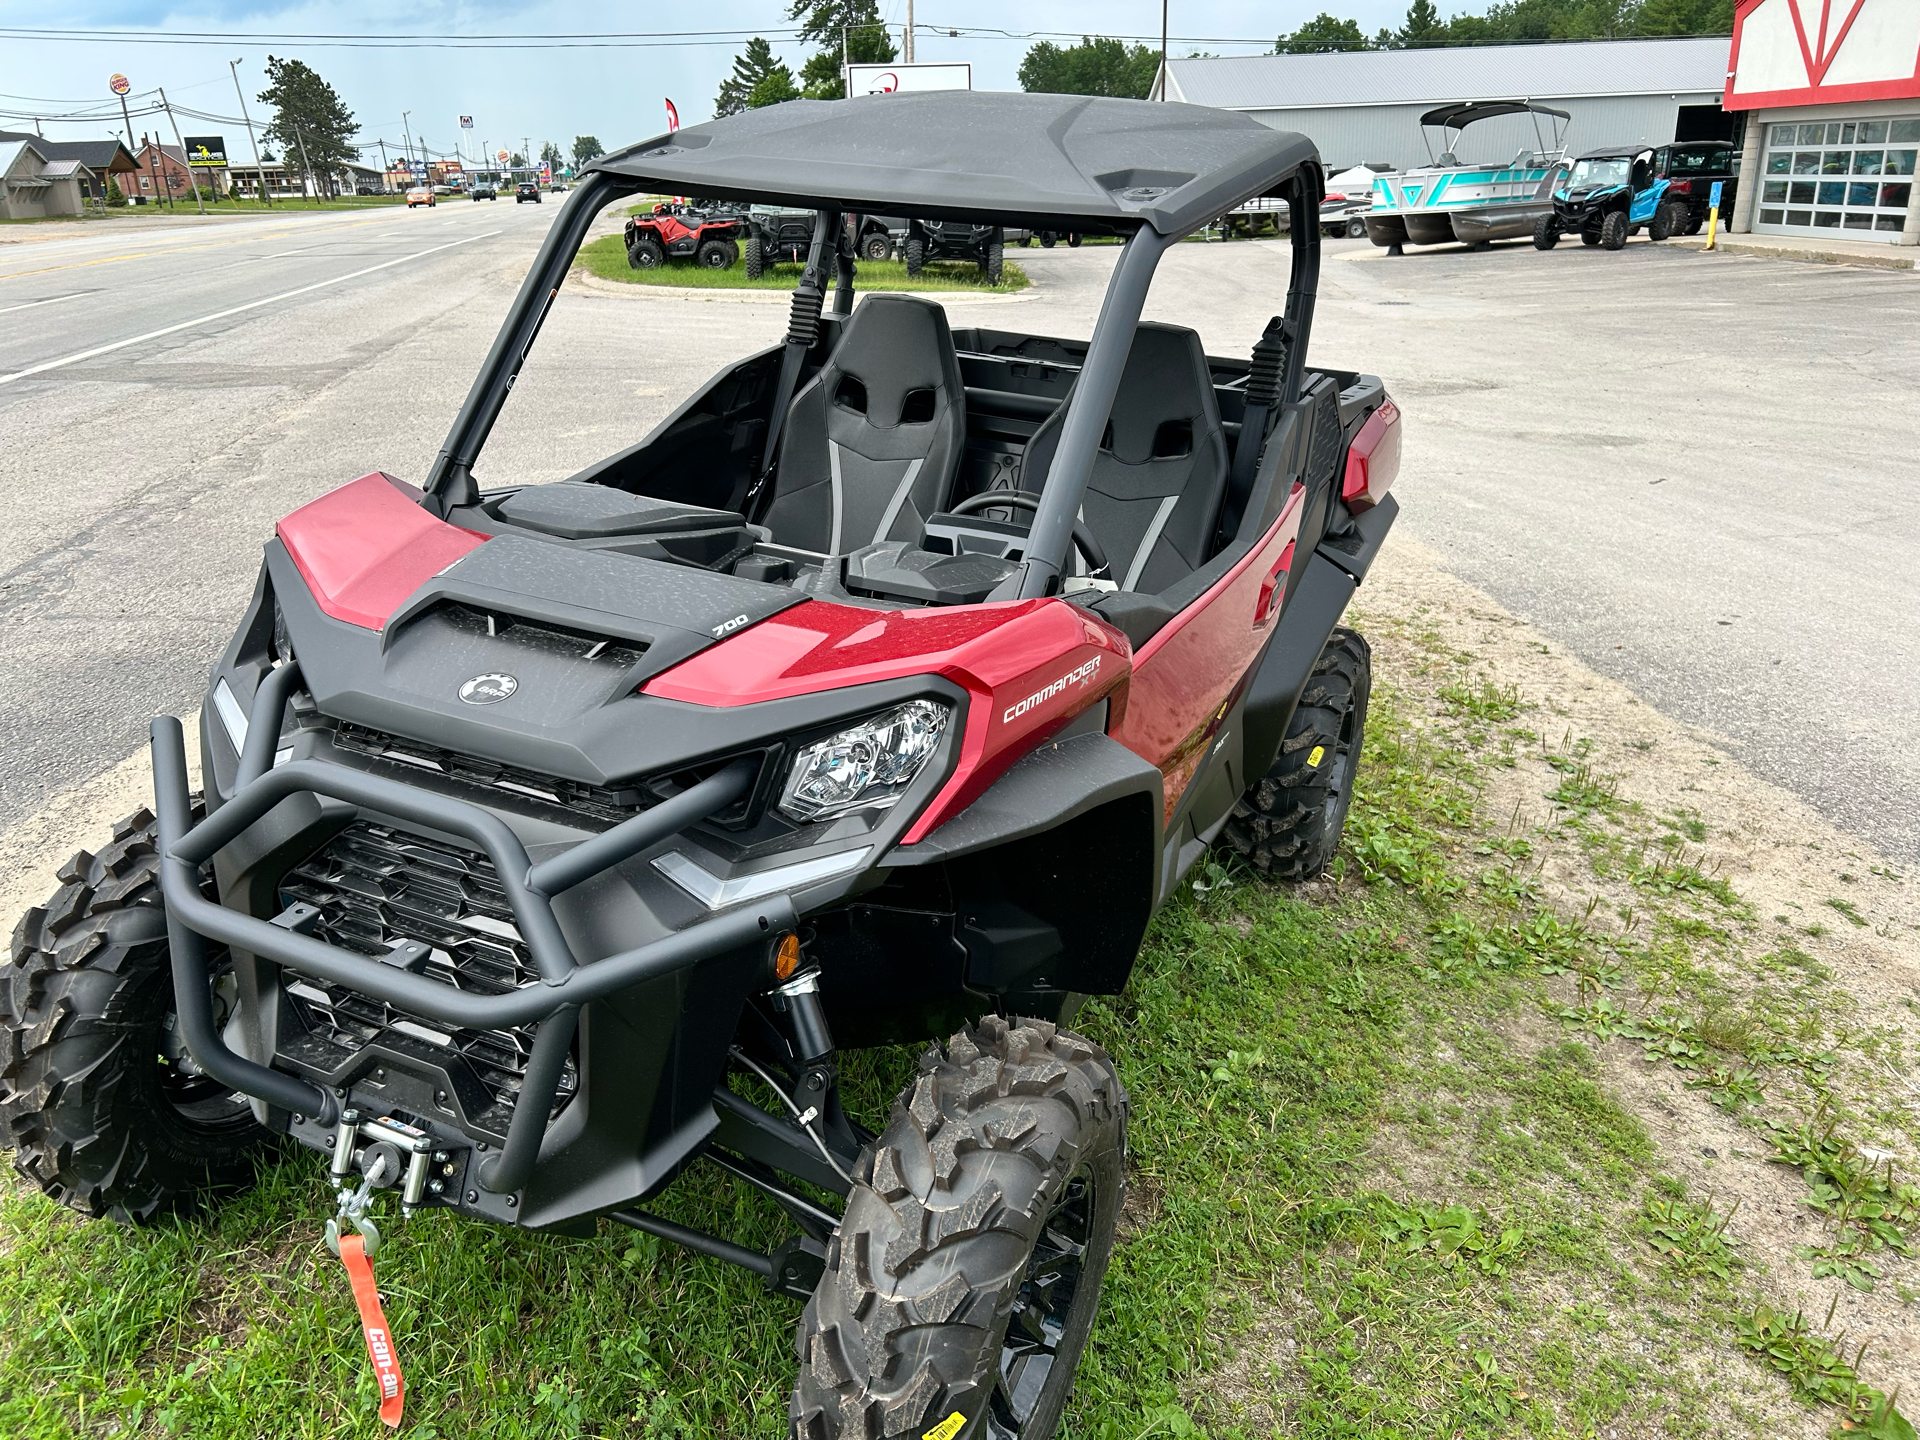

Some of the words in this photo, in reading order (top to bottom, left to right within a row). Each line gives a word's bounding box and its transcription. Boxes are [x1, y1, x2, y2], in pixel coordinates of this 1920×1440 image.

[113, 81, 129, 90] KING
[712, 614, 749, 636] 700
[1079, 669, 1100, 689] XT
[477, 685, 506, 698] BRP
[1003, 655, 1101, 724] COMMANDER
